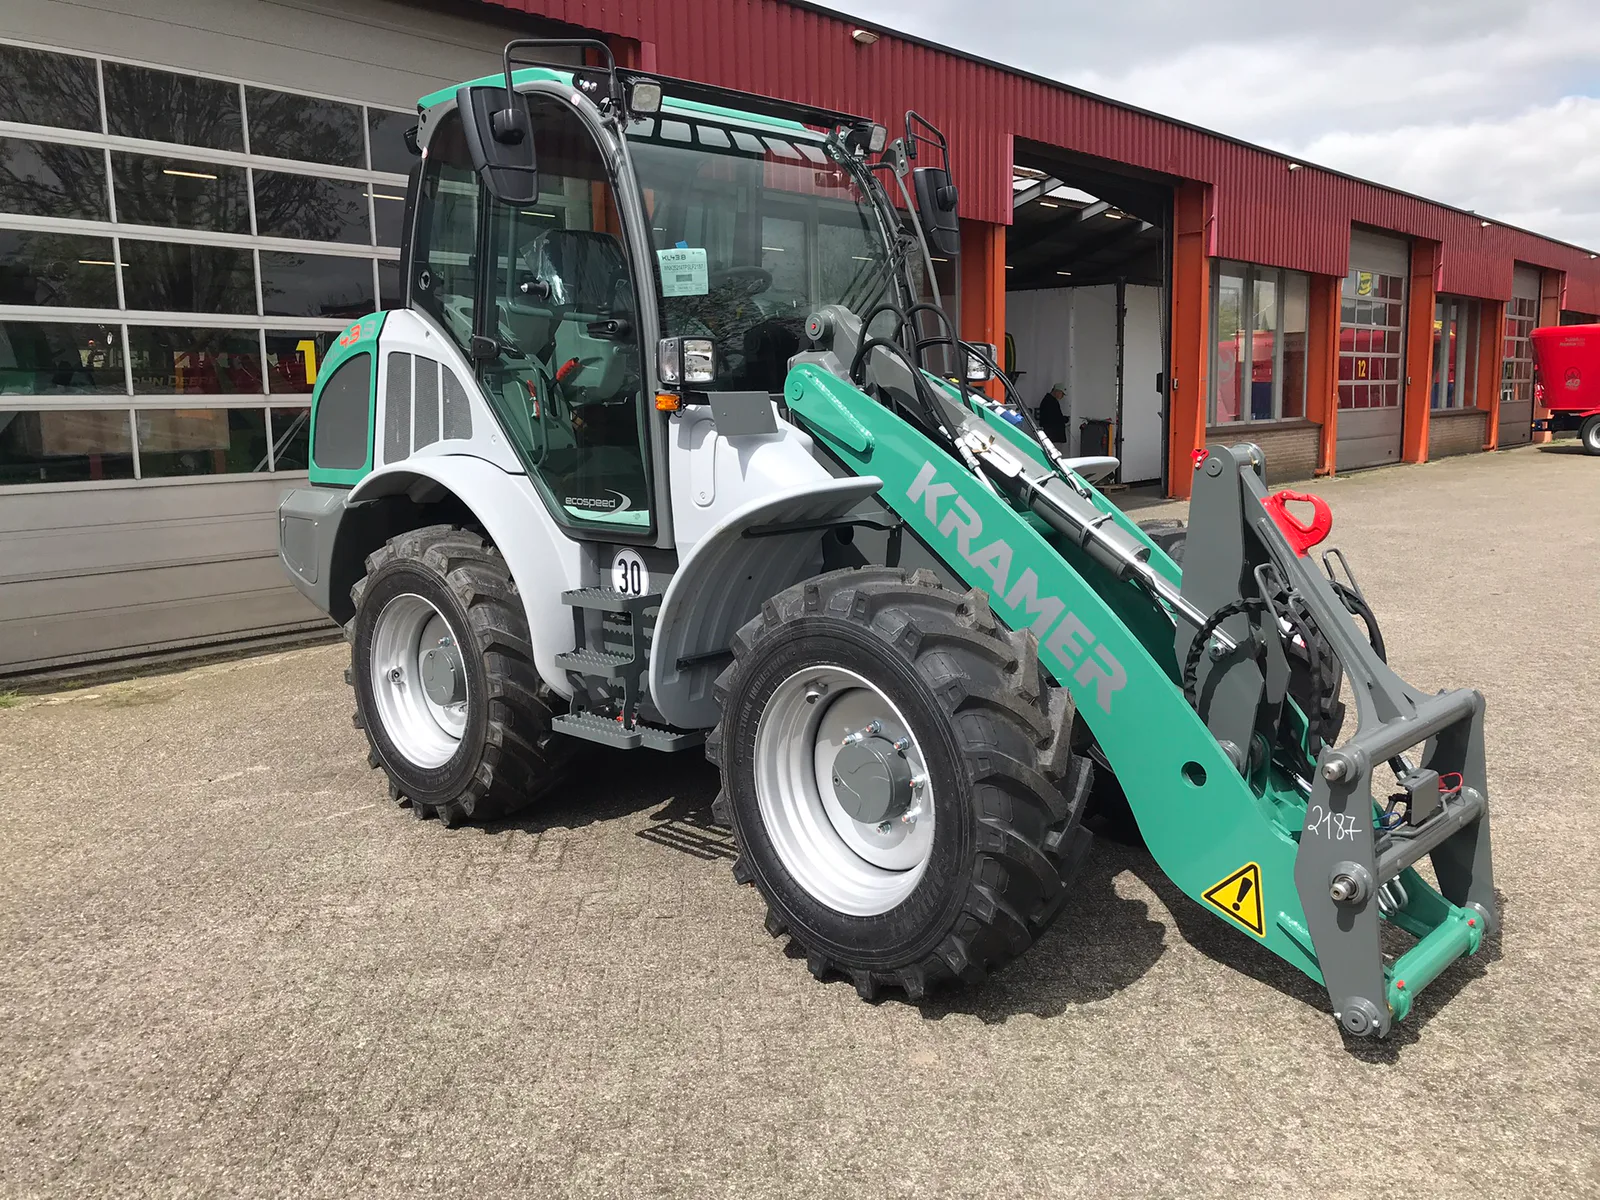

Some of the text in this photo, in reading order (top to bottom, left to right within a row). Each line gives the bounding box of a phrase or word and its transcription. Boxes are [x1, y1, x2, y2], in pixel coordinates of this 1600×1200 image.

[1357, 359, 1367, 378] 12
[565, 496, 616, 508] ecospeed
[617, 558, 641, 596] 30
[906, 460, 1128, 715] KRAMER
[1307, 805, 1363, 841] 2187
